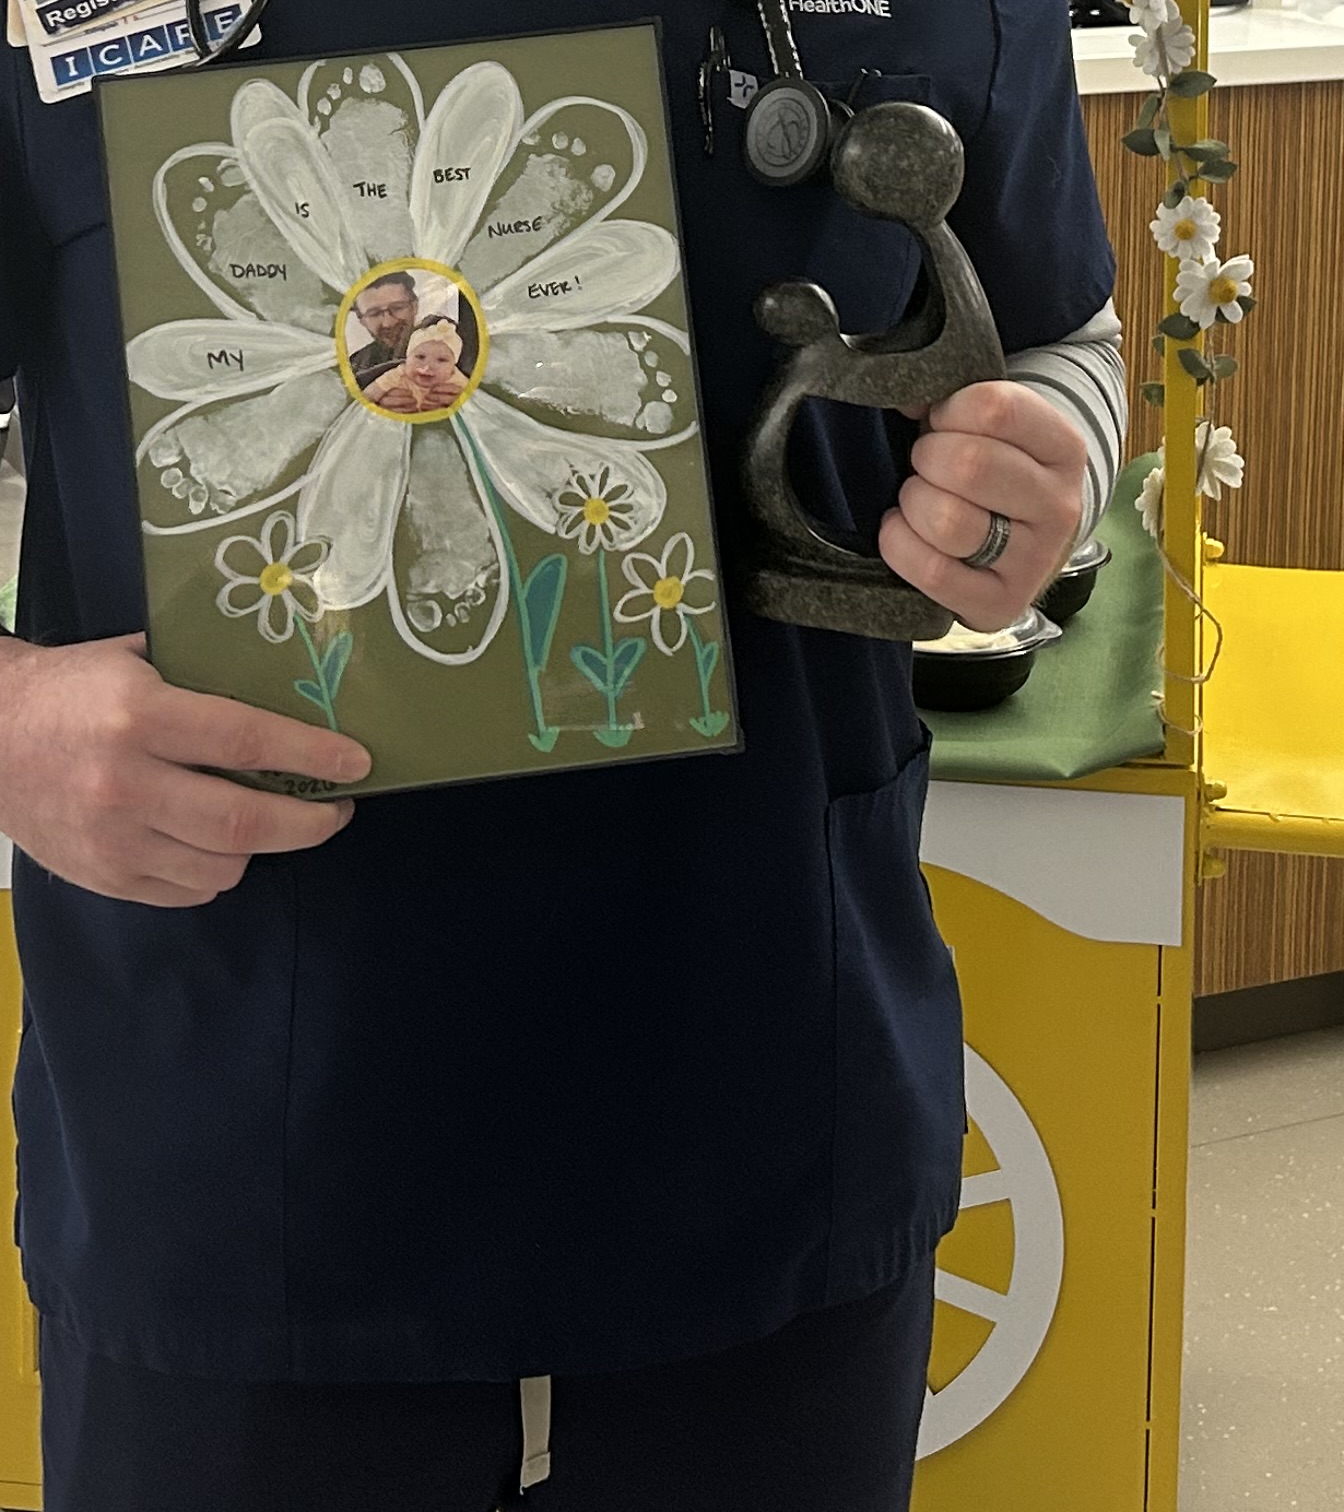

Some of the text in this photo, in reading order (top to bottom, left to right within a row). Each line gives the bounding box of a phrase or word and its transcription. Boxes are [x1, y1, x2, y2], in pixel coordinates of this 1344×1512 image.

[207, 349, 245, 371] MY
[230, 263, 287, 280] DADDY
[295, 201, 310, 218] IS
[353, 181, 388, 199] THE
[433, 167, 471, 183] BEST
[488, 216, 543, 238] NURSE
